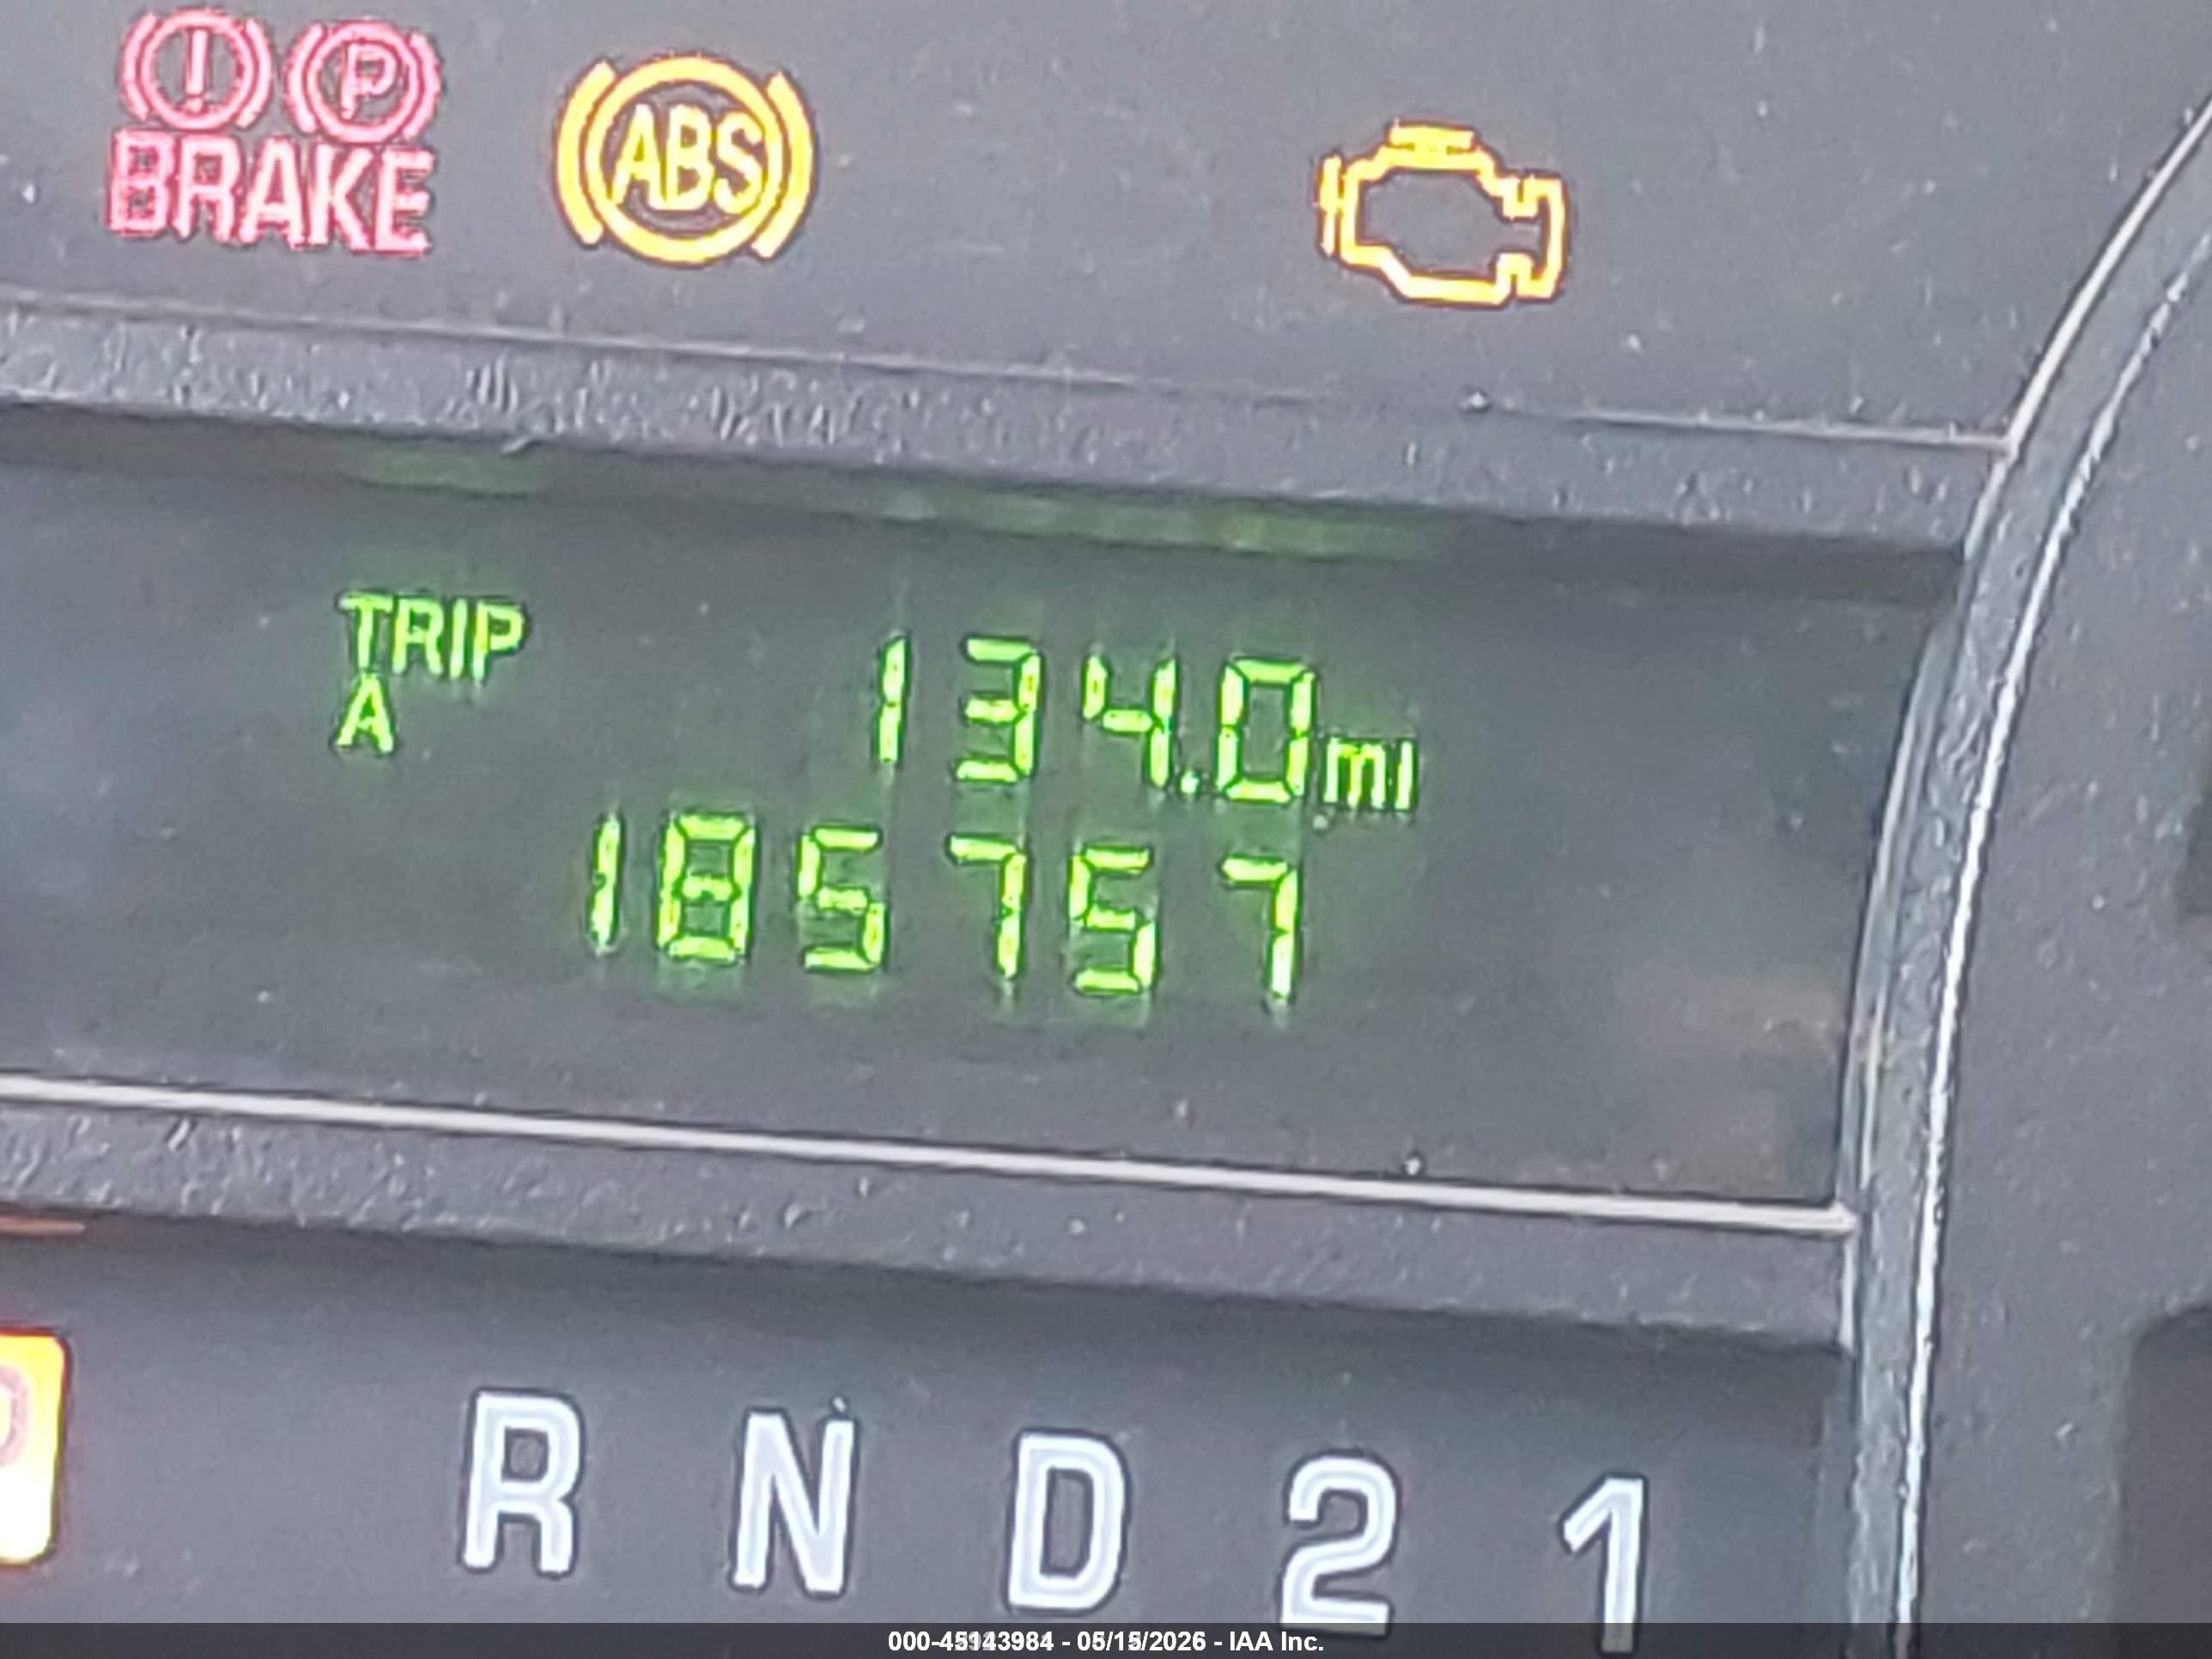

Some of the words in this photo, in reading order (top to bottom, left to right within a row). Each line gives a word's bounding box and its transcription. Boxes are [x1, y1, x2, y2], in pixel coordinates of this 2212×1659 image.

[108, 129, 434, 256] BRAKE
[611, 103, 764, 213] ABS
[336, 592, 526, 683] TRIP
[335, 673, 395, 756] A
[873, 637, 1316, 809] 134.0
[586, 811, 1301, 1005] 185757
[462, 1391, 581, 1575] R
[732, 1410, 855, 1595] N
[1008, 1433, 1127, 1611] D
[1278, 1455, 1398, 1636] 2
[1561, 1478, 1647, 1653] 1
